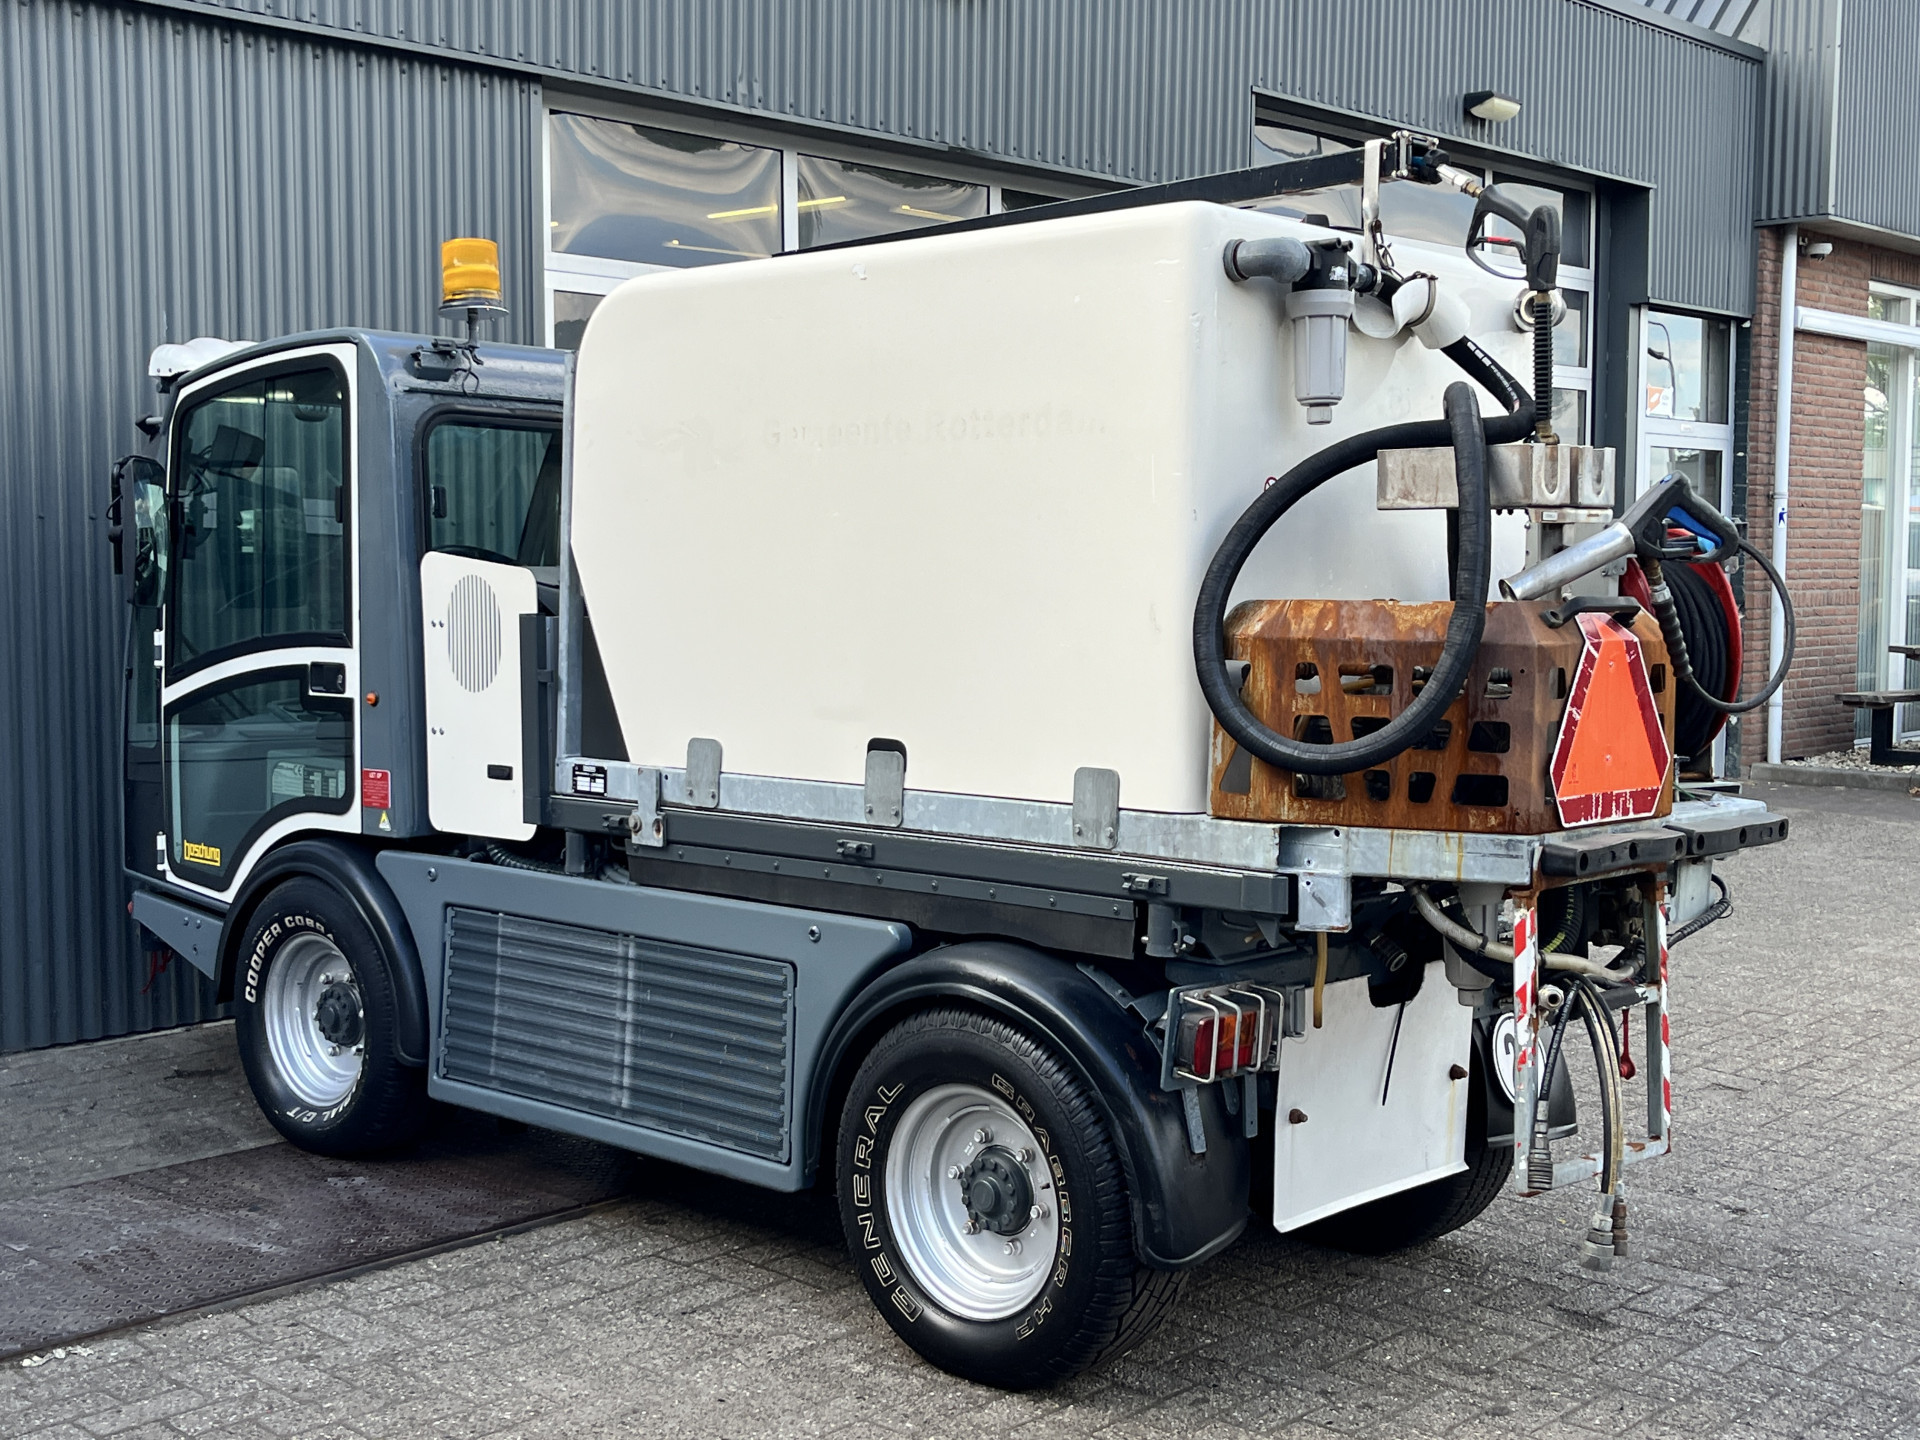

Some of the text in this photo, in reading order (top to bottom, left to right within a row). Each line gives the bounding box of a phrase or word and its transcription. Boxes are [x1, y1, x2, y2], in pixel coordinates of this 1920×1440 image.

[245, 922, 282, 1003] COOPER
[853, 1072, 1072, 1340] GENERAL GRABBER HP
